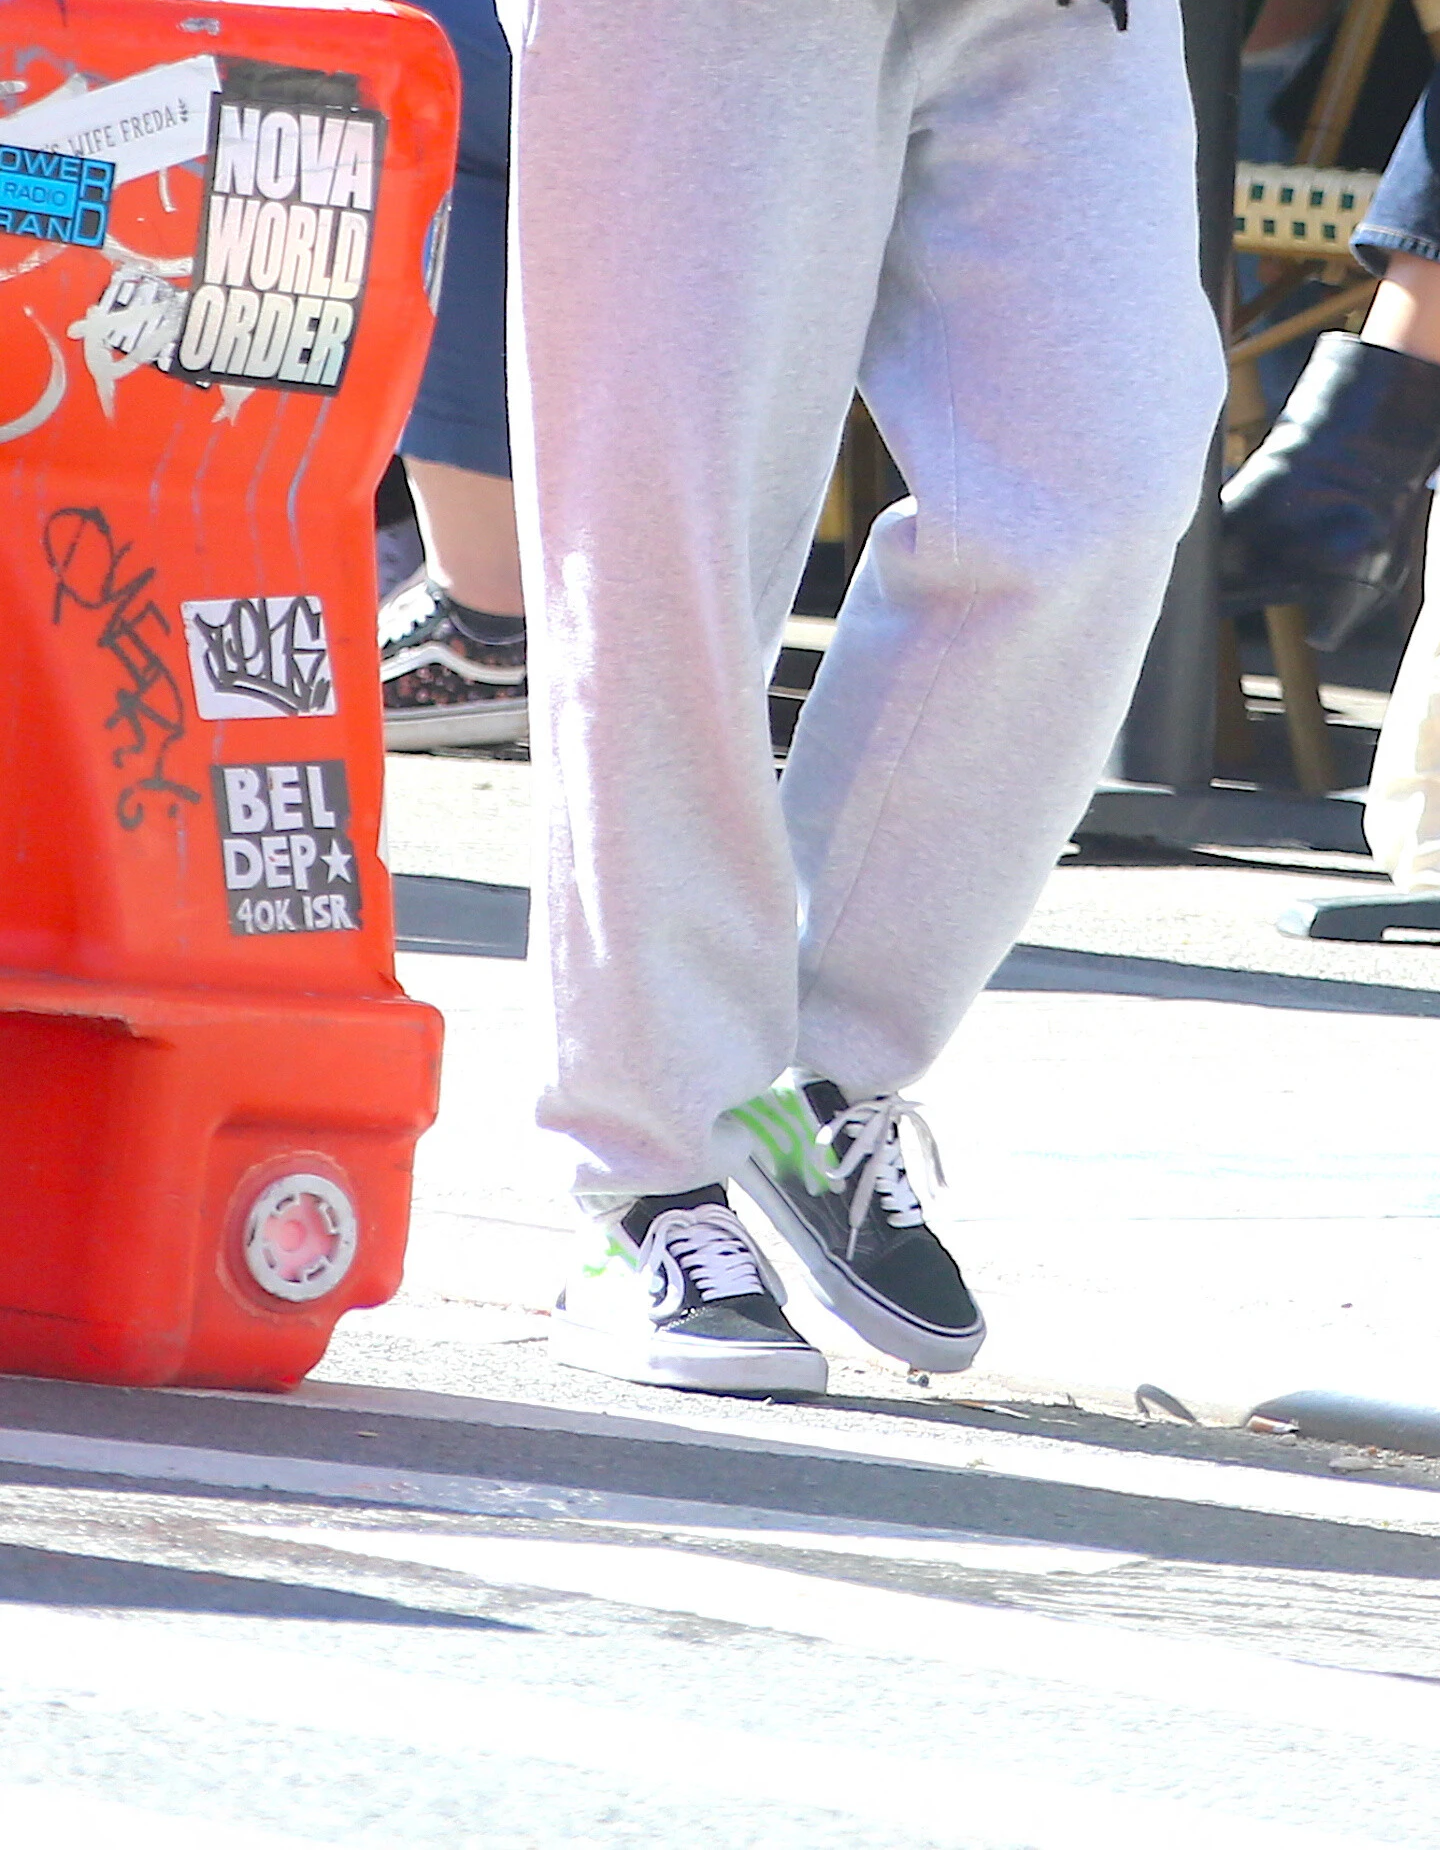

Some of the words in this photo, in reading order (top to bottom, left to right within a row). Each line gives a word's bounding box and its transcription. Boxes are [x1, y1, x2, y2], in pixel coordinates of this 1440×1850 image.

[66, 125, 116, 158] WIFE
[119, 105, 178, 143] FREDA
[213, 103, 375, 212] NOVA
[3, 181, 68, 207] RADIO
[203, 195, 369, 300] WORLD
[178, 285, 355, 386] ORDER
[222, 765, 337, 834] BEL
[222, 834, 317, 891] DEP
[303, 894, 356, 930] ISR
